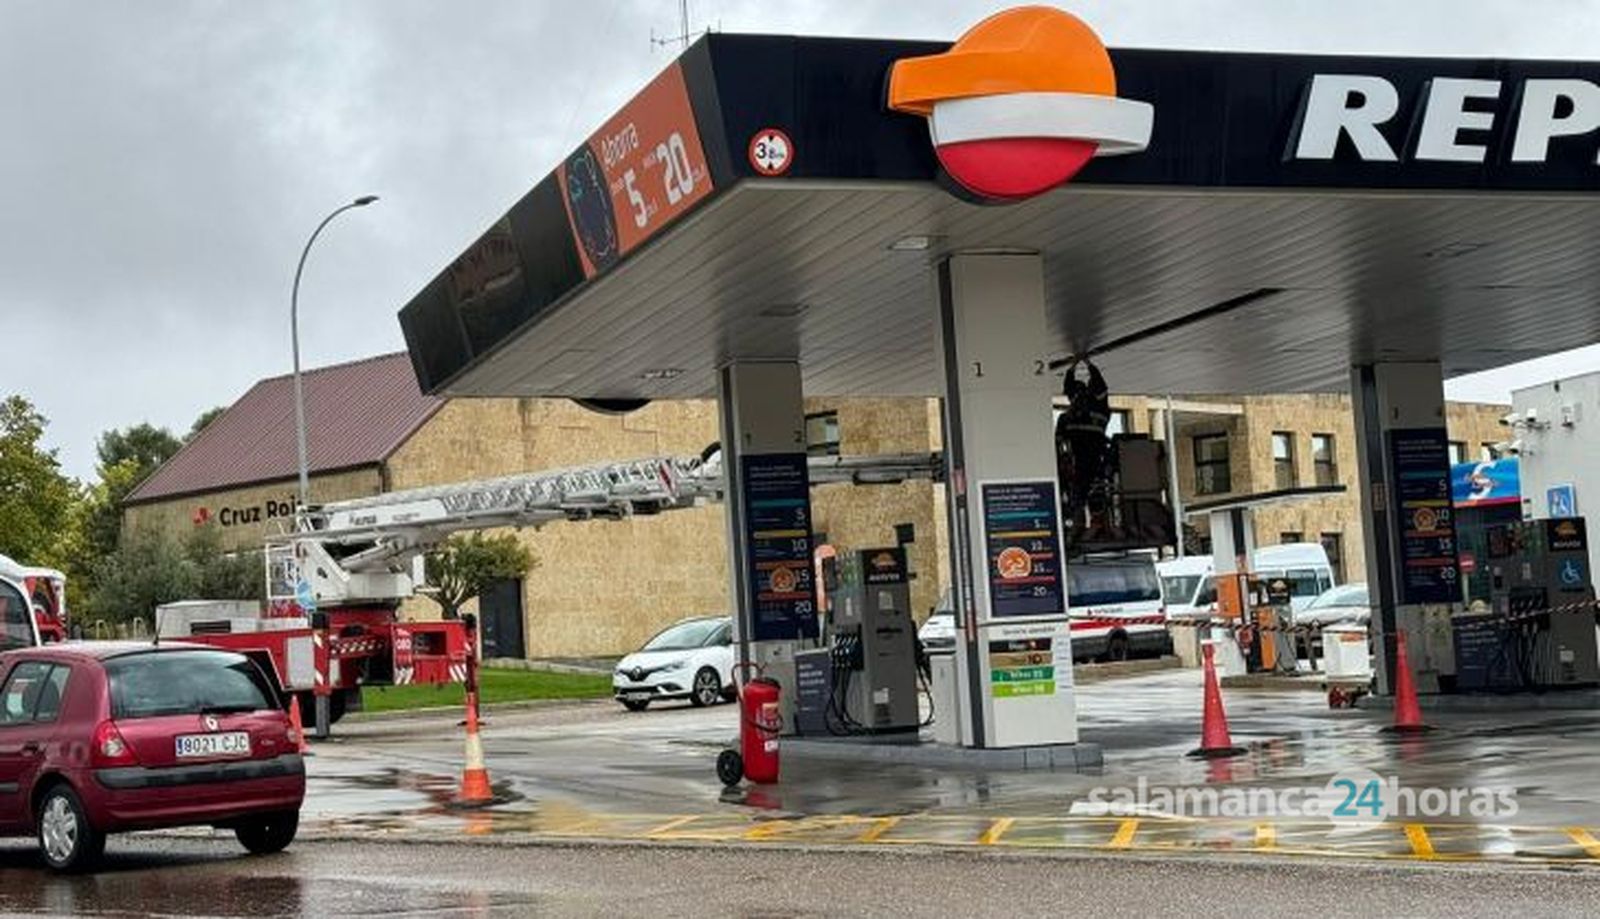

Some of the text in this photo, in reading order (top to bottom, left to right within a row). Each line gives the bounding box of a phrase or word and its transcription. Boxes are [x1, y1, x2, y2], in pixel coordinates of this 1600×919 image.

[1293, 73, 1600, 164] REP
[656, 131, 694, 206] 20
[623, 167, 648, 229] 5
[974, 362, 984, 377] 1
[1033, 360, 1045, 376] 2
[1438, 478, 1448, 492] 5
[218, 506, 261, 527] Cruz
[792, 538, 808, 552] 10
[1441, 566, 1457, 580] 20
[1033, 586, 1047, 597] 20
[794, 600, 812, 614] 20
[184, 735, 247, 754] 8021 CJC
